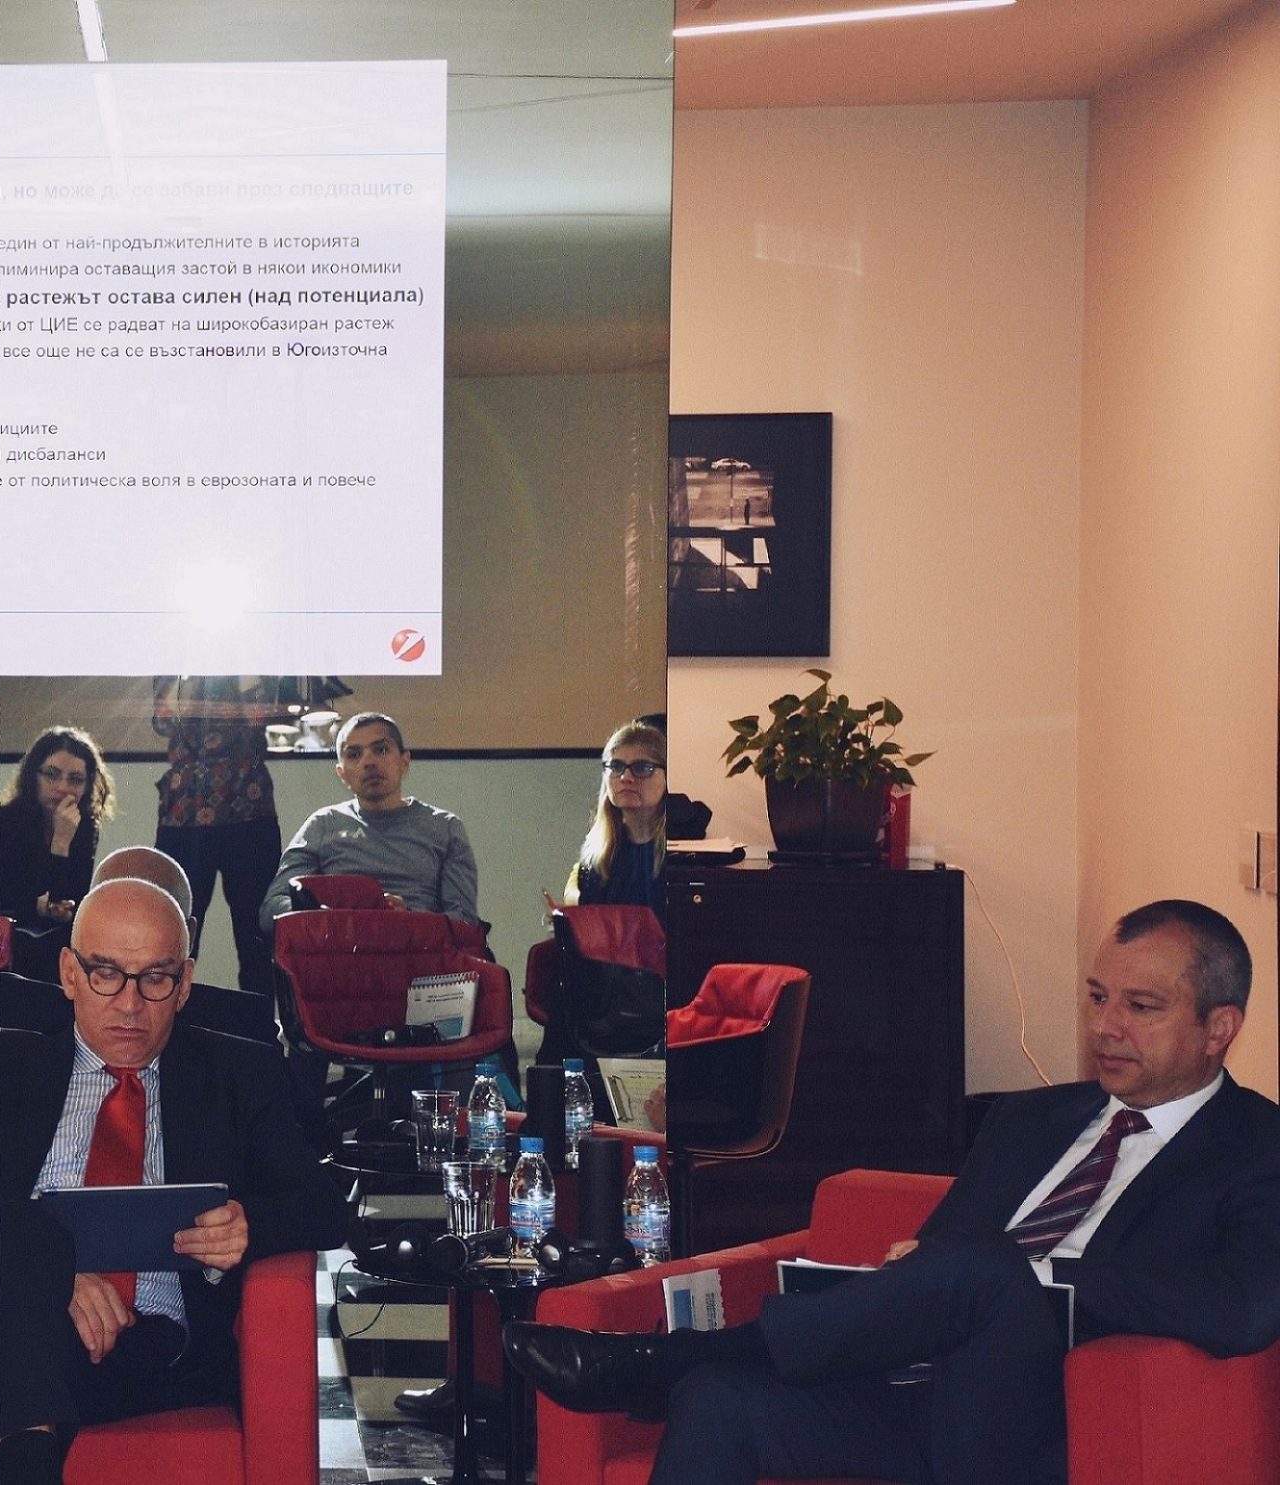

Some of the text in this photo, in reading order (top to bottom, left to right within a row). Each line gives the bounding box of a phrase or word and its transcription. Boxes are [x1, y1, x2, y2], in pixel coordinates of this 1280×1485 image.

[13, 185, 37, 199] но
[44, 185, 95, 199] може
[100, 183, 127, 201] д
[236, 183, 284, 201] през
[287, 182, 415, 200] следващите
[41, 238, 61, 250] от
[65, 234, 254, 252] най-продължителните
[258, 237, 269, 249] в
[273, 236, 360, 252] историята
[83, 263, 176, 279] оставащия
[180, 260, 238, 276] застой
[242, 263, 253, 275] в
[257, 263, 306, 275] някои
[311, 262, 402, 275] икономики
[6, 292, 102, 309] растежът
[107, 291, 176, 305] остава
[182, 291, 242, 305] силен
[247, 288, 292, 308] (над
[297, 287, 424, 307] потенциала)
[16, 320, 35, 332] от
[40, 316, 78, 335] ЦИЕ
[83, 320, 102, 332] се
[108, 319, 166, 335] радват
[171, 319, 191, 331] на
[196, 315, 329, 334] широкобазиран
[334, 318, 395, 333] растеж
[2, 346, 31, 358] все
[35, 346, 71, 358] още
[76, 346, 96, 358] не
[100, 346, 120, 358] са
[125, 346, 144, 358] се
[149, 345, 266, 358] възстановили
[271, 345, 281, 357] в
[287, 341, 388, 359] Югоизточна
[5, 446, 106, 464] дисбаланси
[8, 476, 26, 488] от
[31, 475, 137, 488] политическа
[141, 476, 181, 487] воля
[186, 476, 196, 487] в
[200, 475, 297, 490] еврозоната
[302, 475, 312, 487] и
[318, 475, 376, 487] повече
